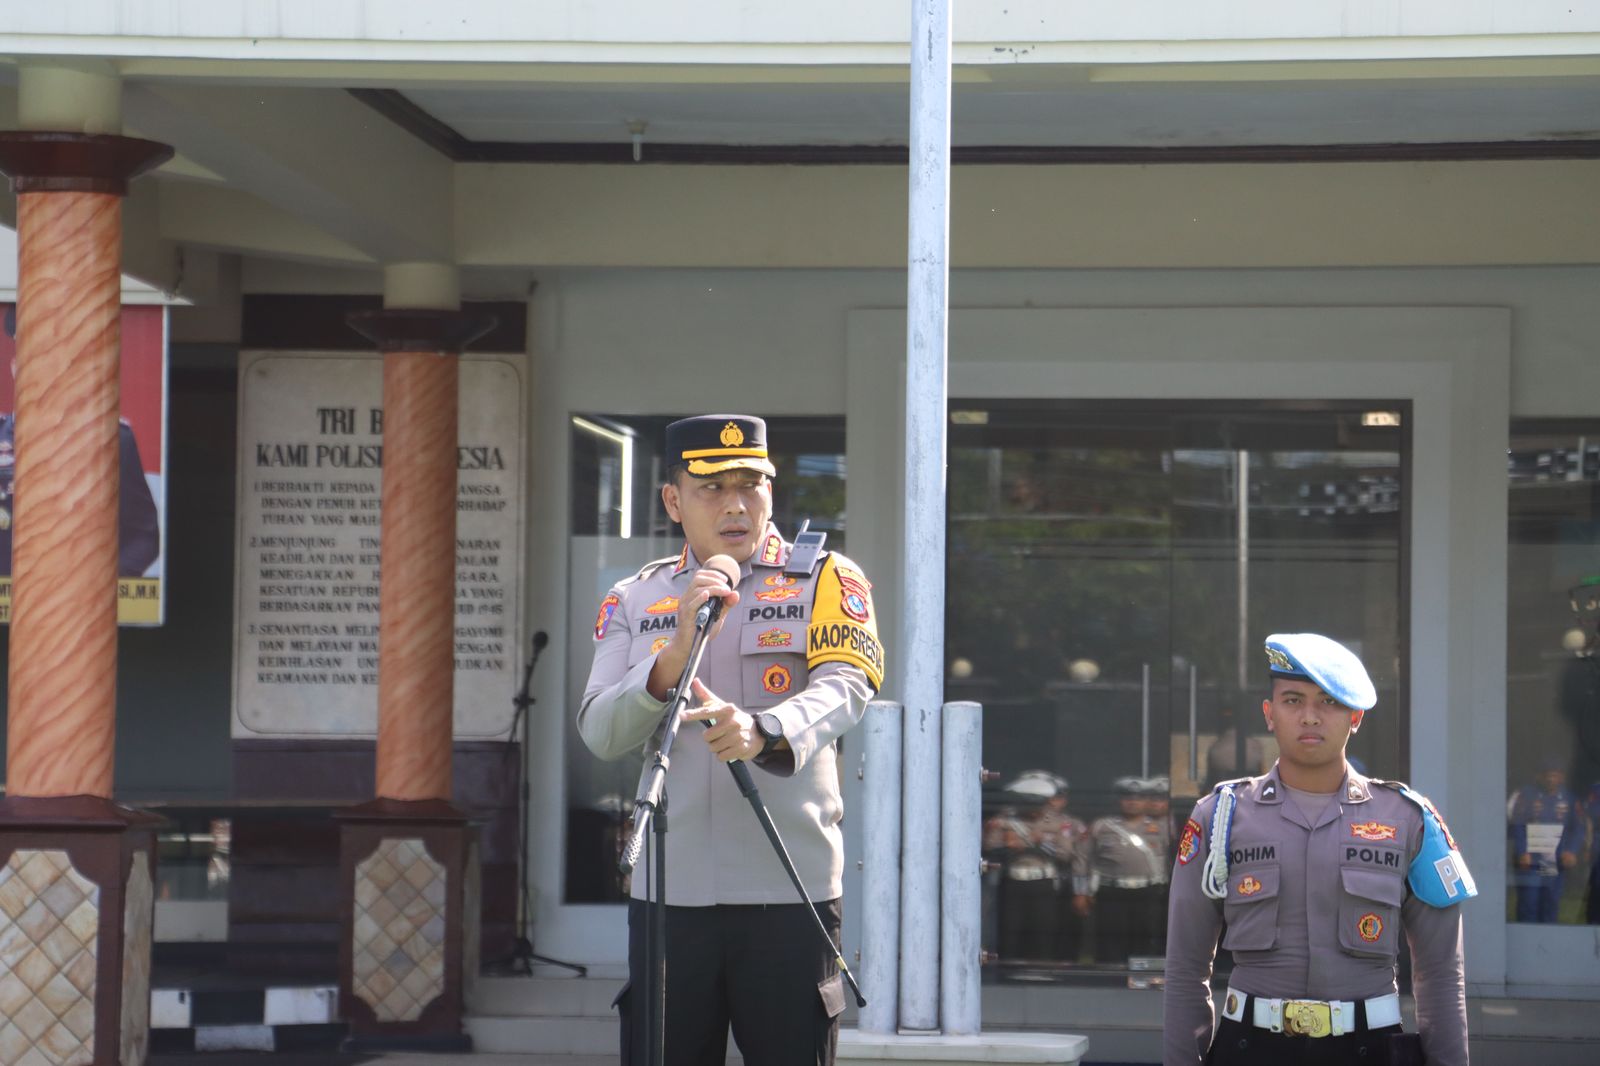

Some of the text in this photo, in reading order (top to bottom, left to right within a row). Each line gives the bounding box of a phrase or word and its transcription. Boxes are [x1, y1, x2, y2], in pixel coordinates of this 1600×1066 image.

[317, 408, 356, 435] TRI
[256, 443, 308, 468] KAMI
[330, 483, 376, 494] KEPADA
[261, 497, 312, 509] DENGAN
[317, 498, 355, 509] PENUH
[261, 514, 382, 526] TUHAN YANG MAH
[359, 538, 381, 549] TIN
[260, 553, 324, 564] KEADILAN
[329, 554, 354, 565] DAN
[259, 569, 354, 580] MENEGAKKAN
[259, 585, 326, 596] KESATUAN
[470, 588, 504, 599] YANG
[259, 601, 352, 613] BERDASARKAN
[749, 605, 804, 621] POLRI
[640, 616, 677, 633] RAM
[258, 641, 284, 651] DAN
[290, 641, 352, 652] MELAYANI
[258, 656, 342, 668] KEIKHLASAN
[257, 673, 327, 684] KEAMANAN
[332, 673, 356, 684] DAN
[1346, 847, 1399, 868] POLRI
